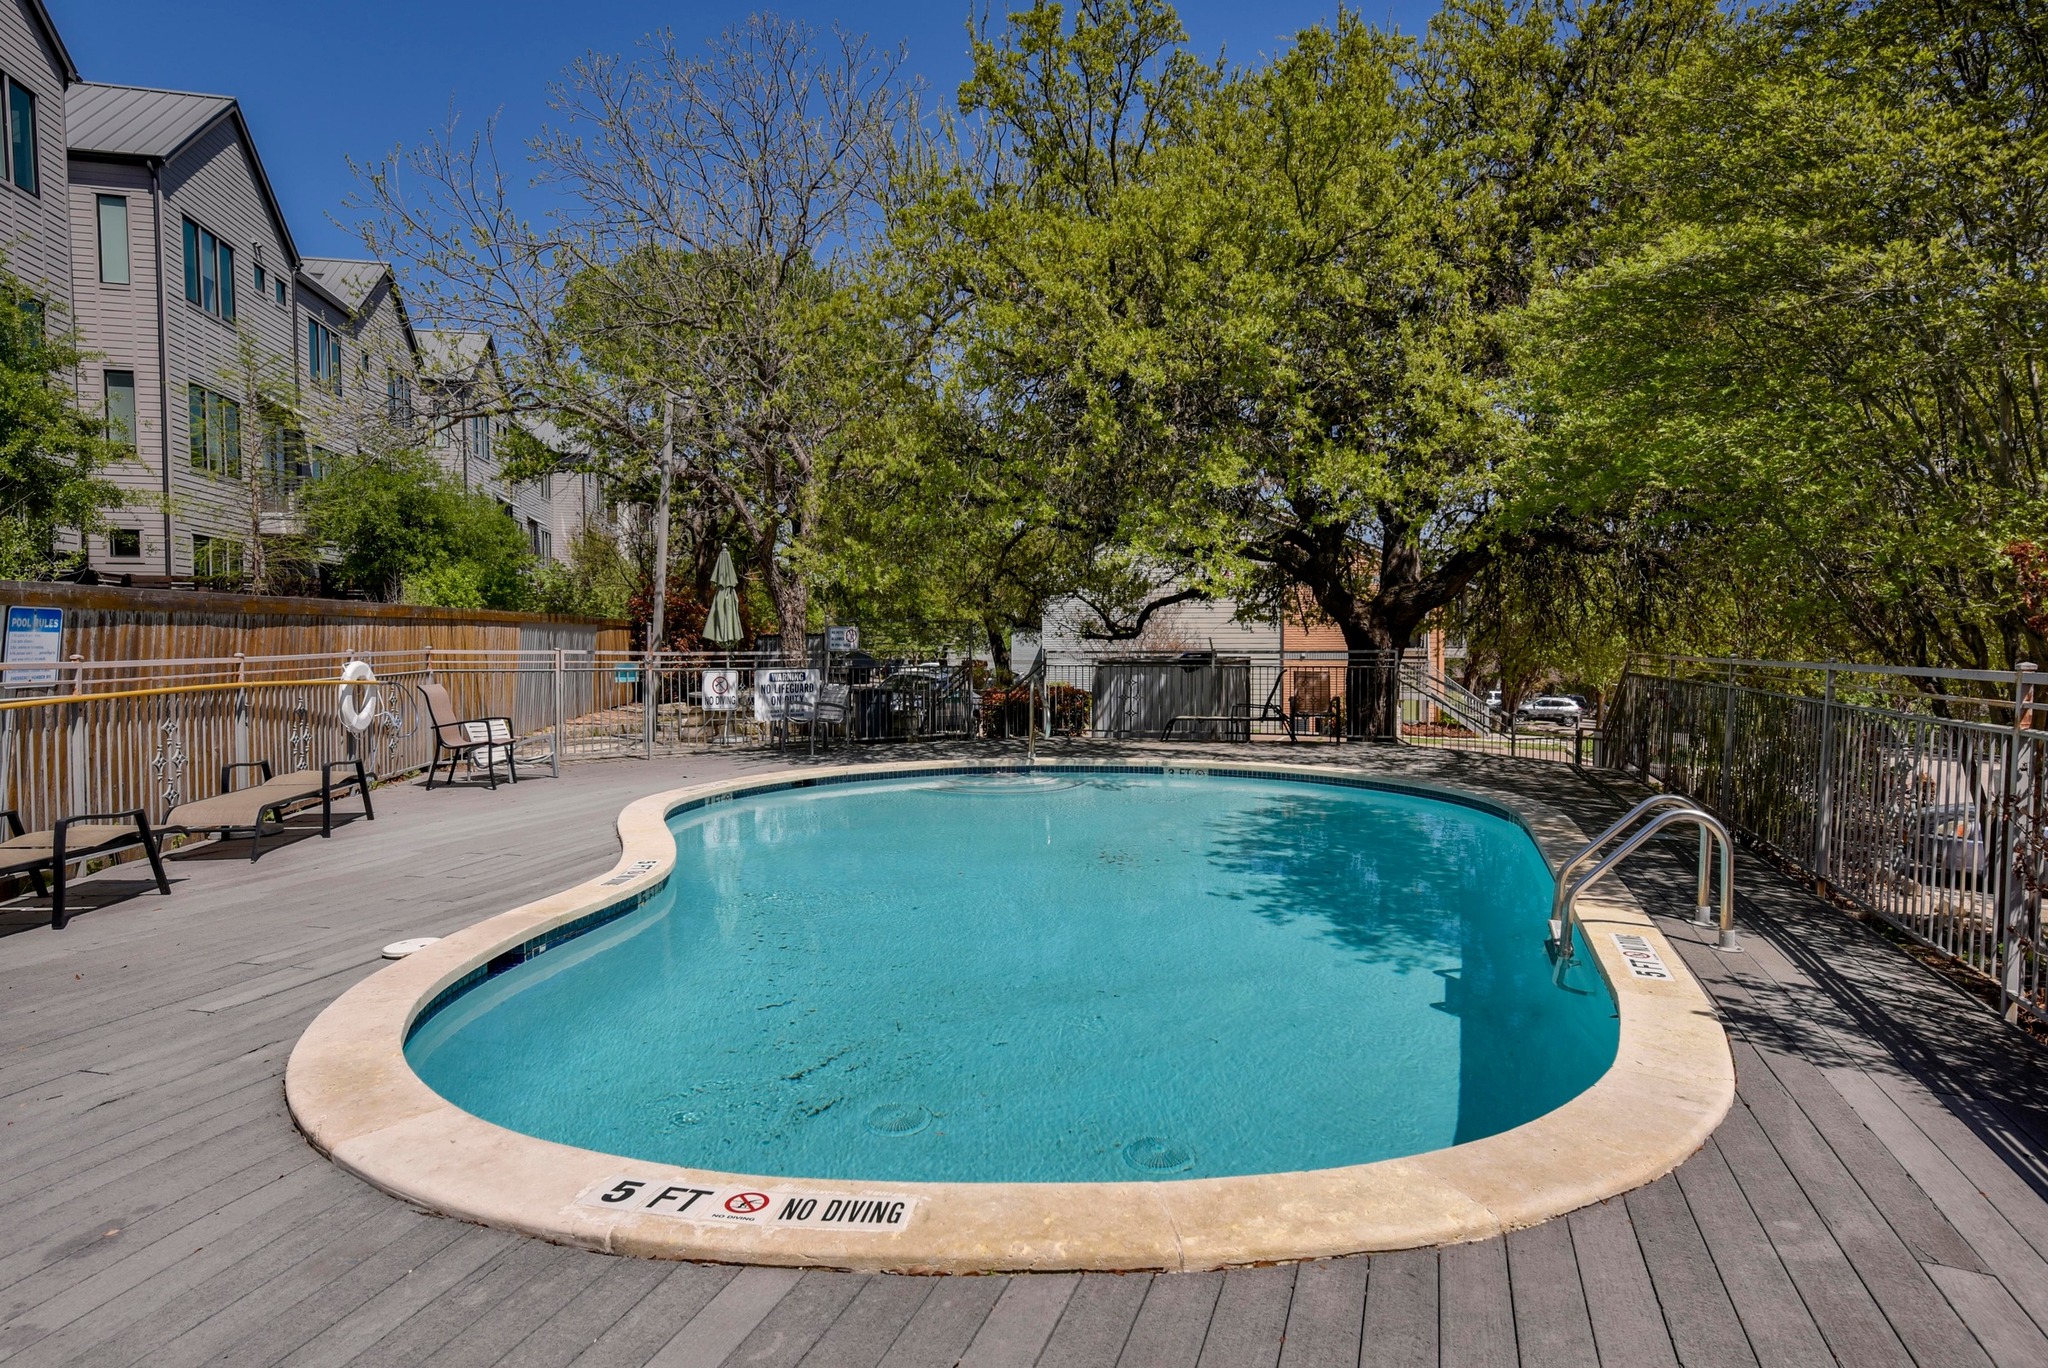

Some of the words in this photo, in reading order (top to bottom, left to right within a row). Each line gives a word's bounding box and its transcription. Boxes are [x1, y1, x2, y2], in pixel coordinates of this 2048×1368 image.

[11, 617, 32, 628] POOL
[34, 618, 59, 629] RULES
[771, 673, 804, 681] WARNING
[760, 684, 771, 694] NO
[774, 683, 814, 693] LIFEGUARD
[704, 695, 714, 706] NO
[715, 695, 736, 706] DIVING
[771, 696, 782, 706] ON
[784, 694, 804, 703] DUTY
[600, 1180, 647, 1203] 5
[645, 1186, 715, 1212] FT
[777, 1198, 818, 1220] NO
[820, 1199, 906, 1224] DIVING
